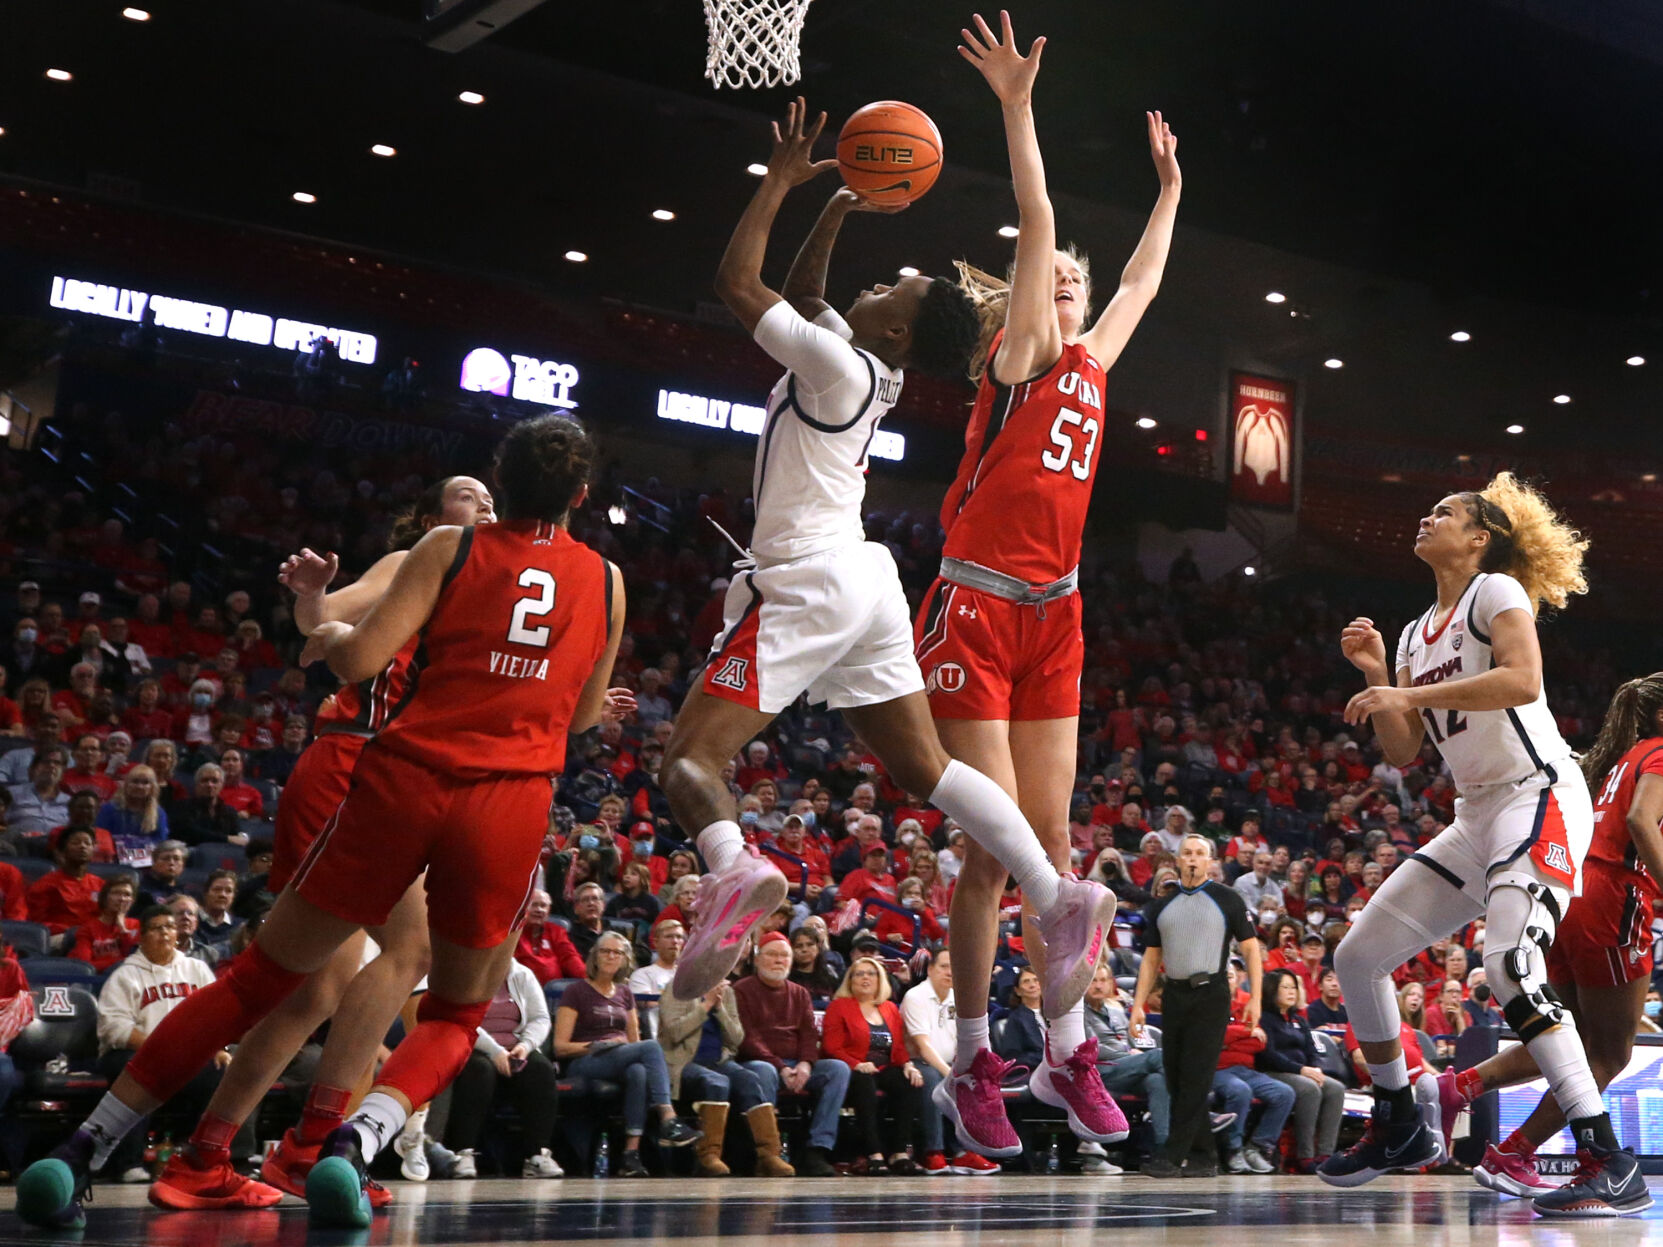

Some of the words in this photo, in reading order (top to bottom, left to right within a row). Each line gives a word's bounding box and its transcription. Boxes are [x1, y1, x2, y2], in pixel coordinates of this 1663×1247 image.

[855, 145, 913, 165] ELITE
[511, 353, 579, 388] TACO
[1041, 405, 1100, 481] 53
[506, 566, 557, 648] 2
[489, 651, 550, 681] VIEIRA
[1597, 761, 1629, 806] 34
